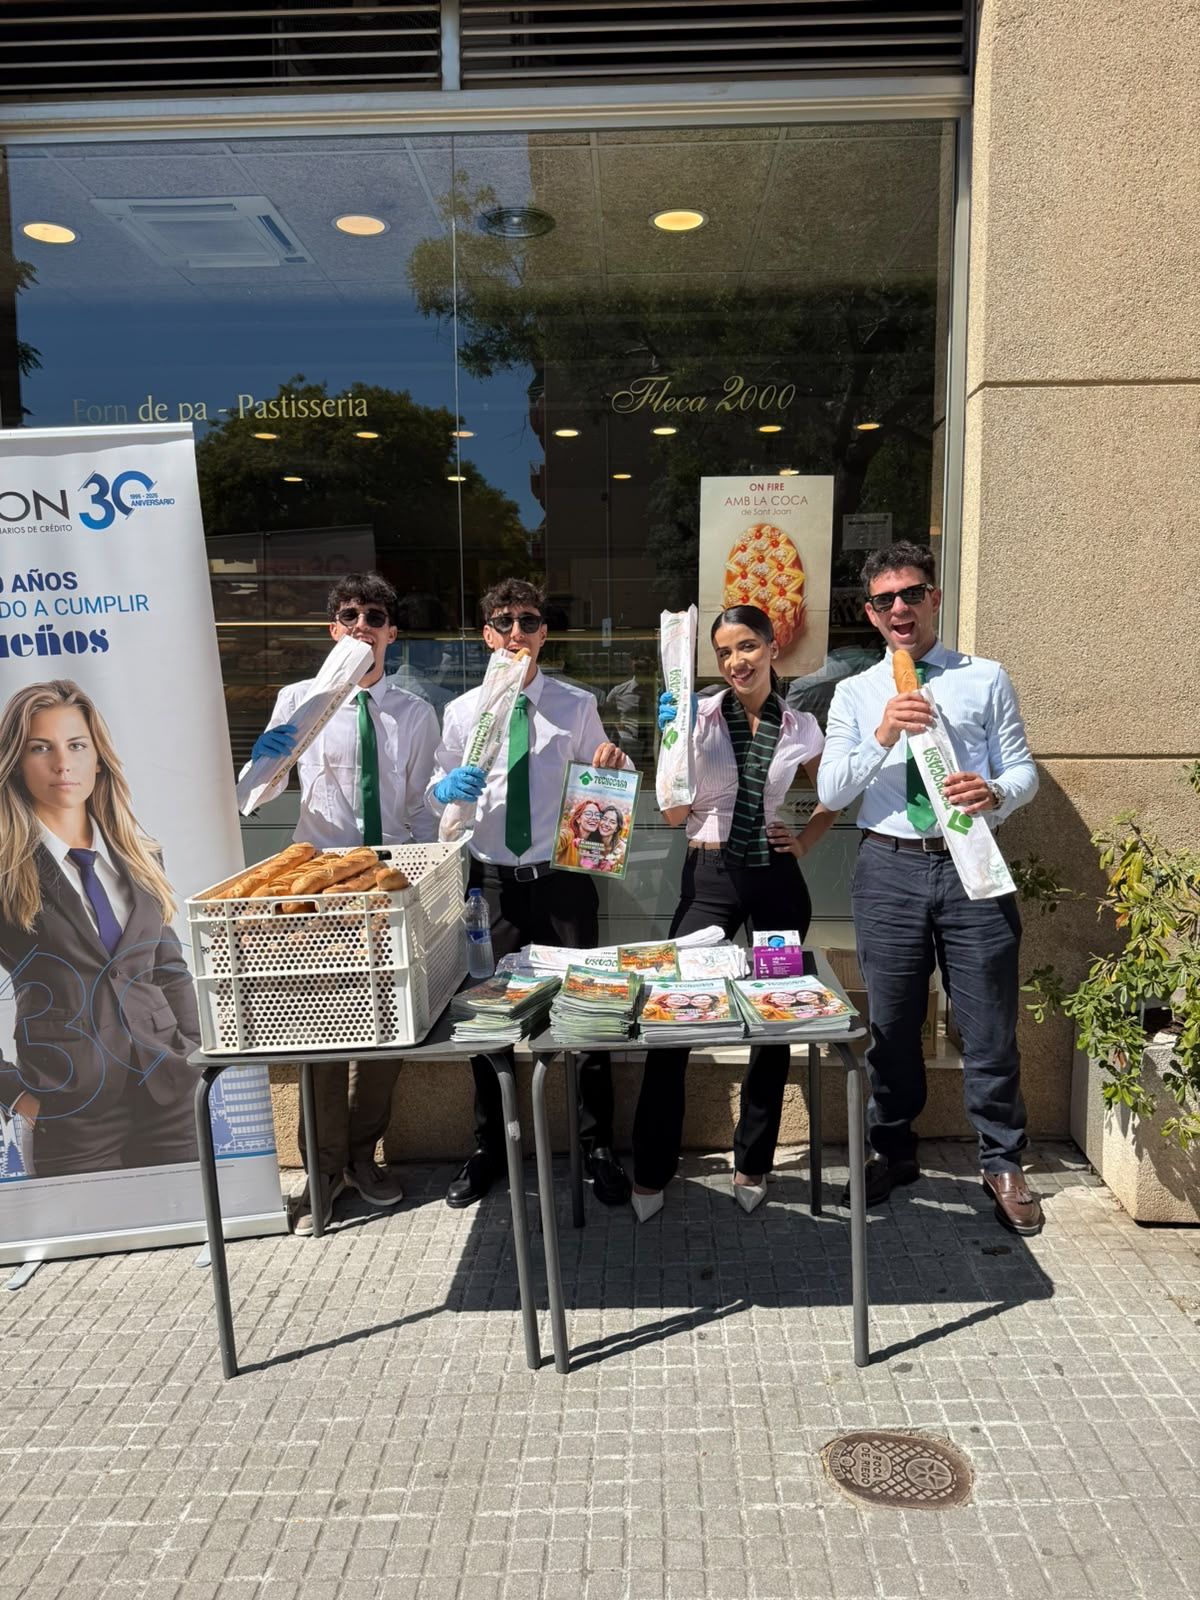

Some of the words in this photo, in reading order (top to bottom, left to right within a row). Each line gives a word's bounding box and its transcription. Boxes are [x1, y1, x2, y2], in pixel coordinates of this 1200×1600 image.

[611, 375, 708, 414] Fleca
[715, 375, 796, 411] 2000
[72, 399, 128, 423] Forn
[138, 395, 168, 422] de
[178, 401, 207, 422] pa
[238, 393, 368, 419] Pastisseria
[749, 483, 764, 492] ON
[767, 482, 785, 491] FIRE
[131, 498, 175, 507] ANIVERSARIO
[725, 496, 751, 506] AMB
[754, 496, 768, 506] LA
[771, 495, 808, 506] COCA
[753, 508, 771, 516] Sant
[773, 508, 792, 516] Joan
[28, 525, 38, 534] DE
[40, 522, 73, 533] CRÉDITO
[11, 568, 78, 593] AÑOS
[34, 599, 49, 616] A
[54, 594, 150, 616] CUMPLIR
[860, 1447, 870, 1459] DE
[860, 1459, 870, 1485] RIEGO
[873, 1454, 882, 1479] BOCA
